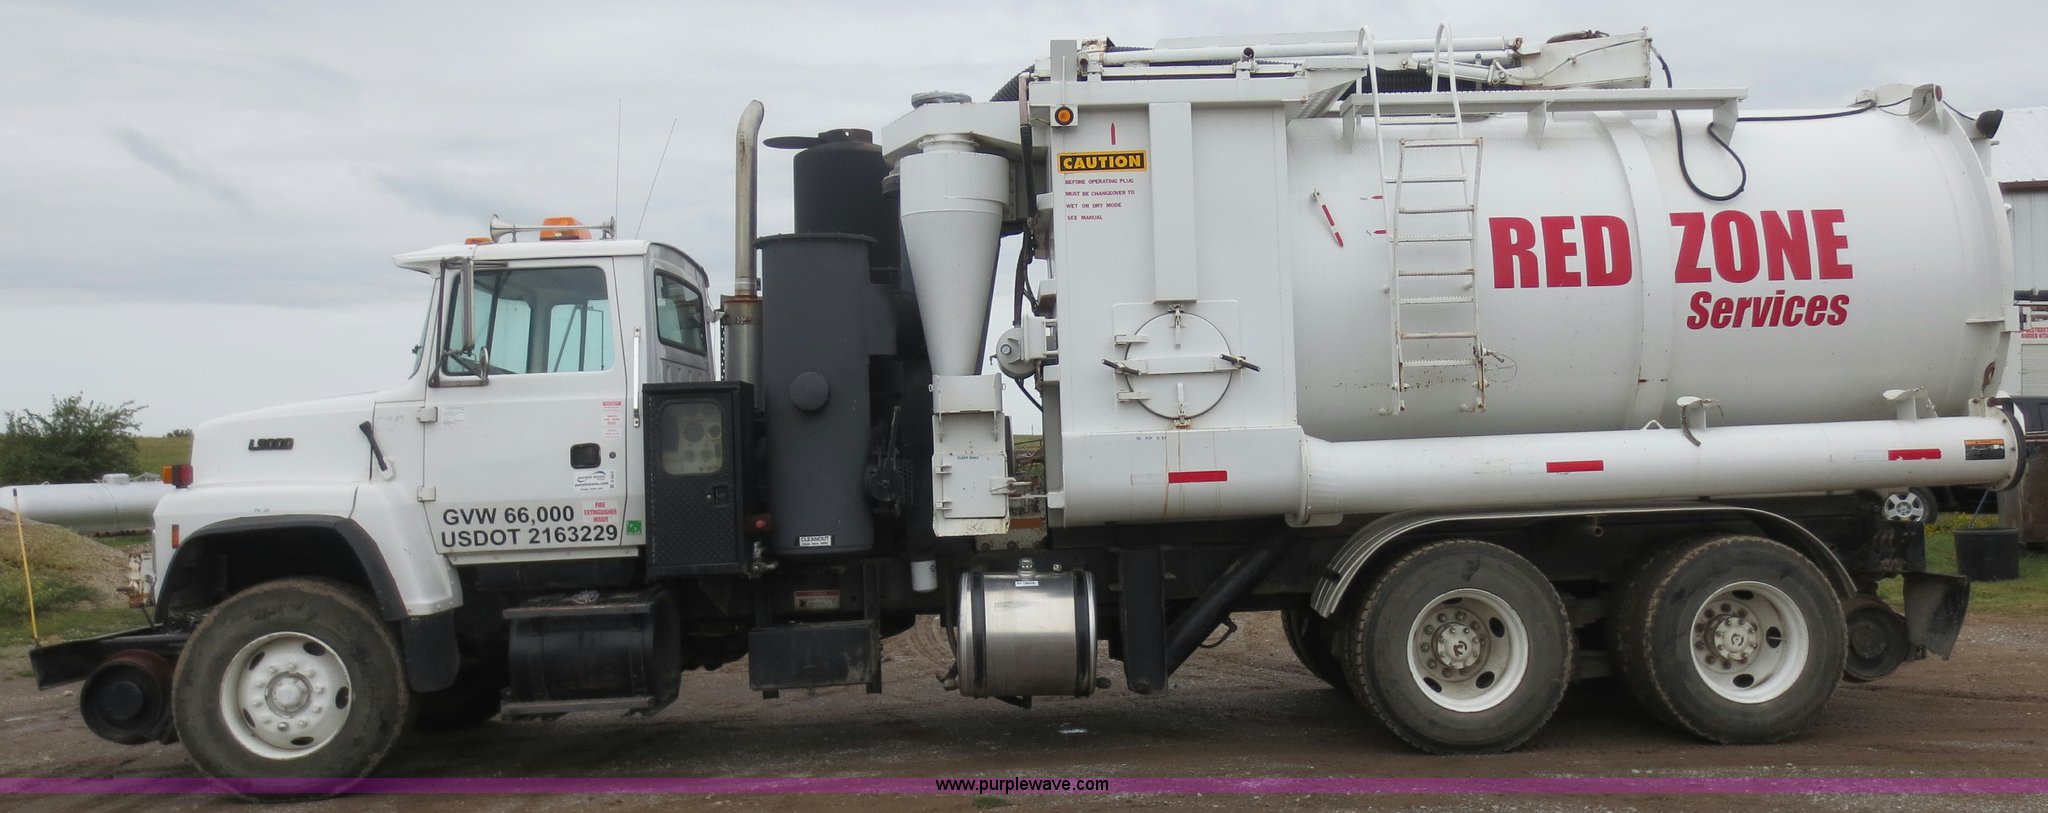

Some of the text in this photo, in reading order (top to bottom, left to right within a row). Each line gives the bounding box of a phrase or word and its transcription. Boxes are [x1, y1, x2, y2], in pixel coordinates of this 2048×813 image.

[1063, 155, 1141, 170] CAUTION
[1489, 209, 1854, 289] RED ZONE
[1686, 289, 1851, 330] Services
[443, 505, 574, 526] GVW 66,000
[441, 529, 520, 547] USDOT
[529, 525, 618, 544] 2163229
